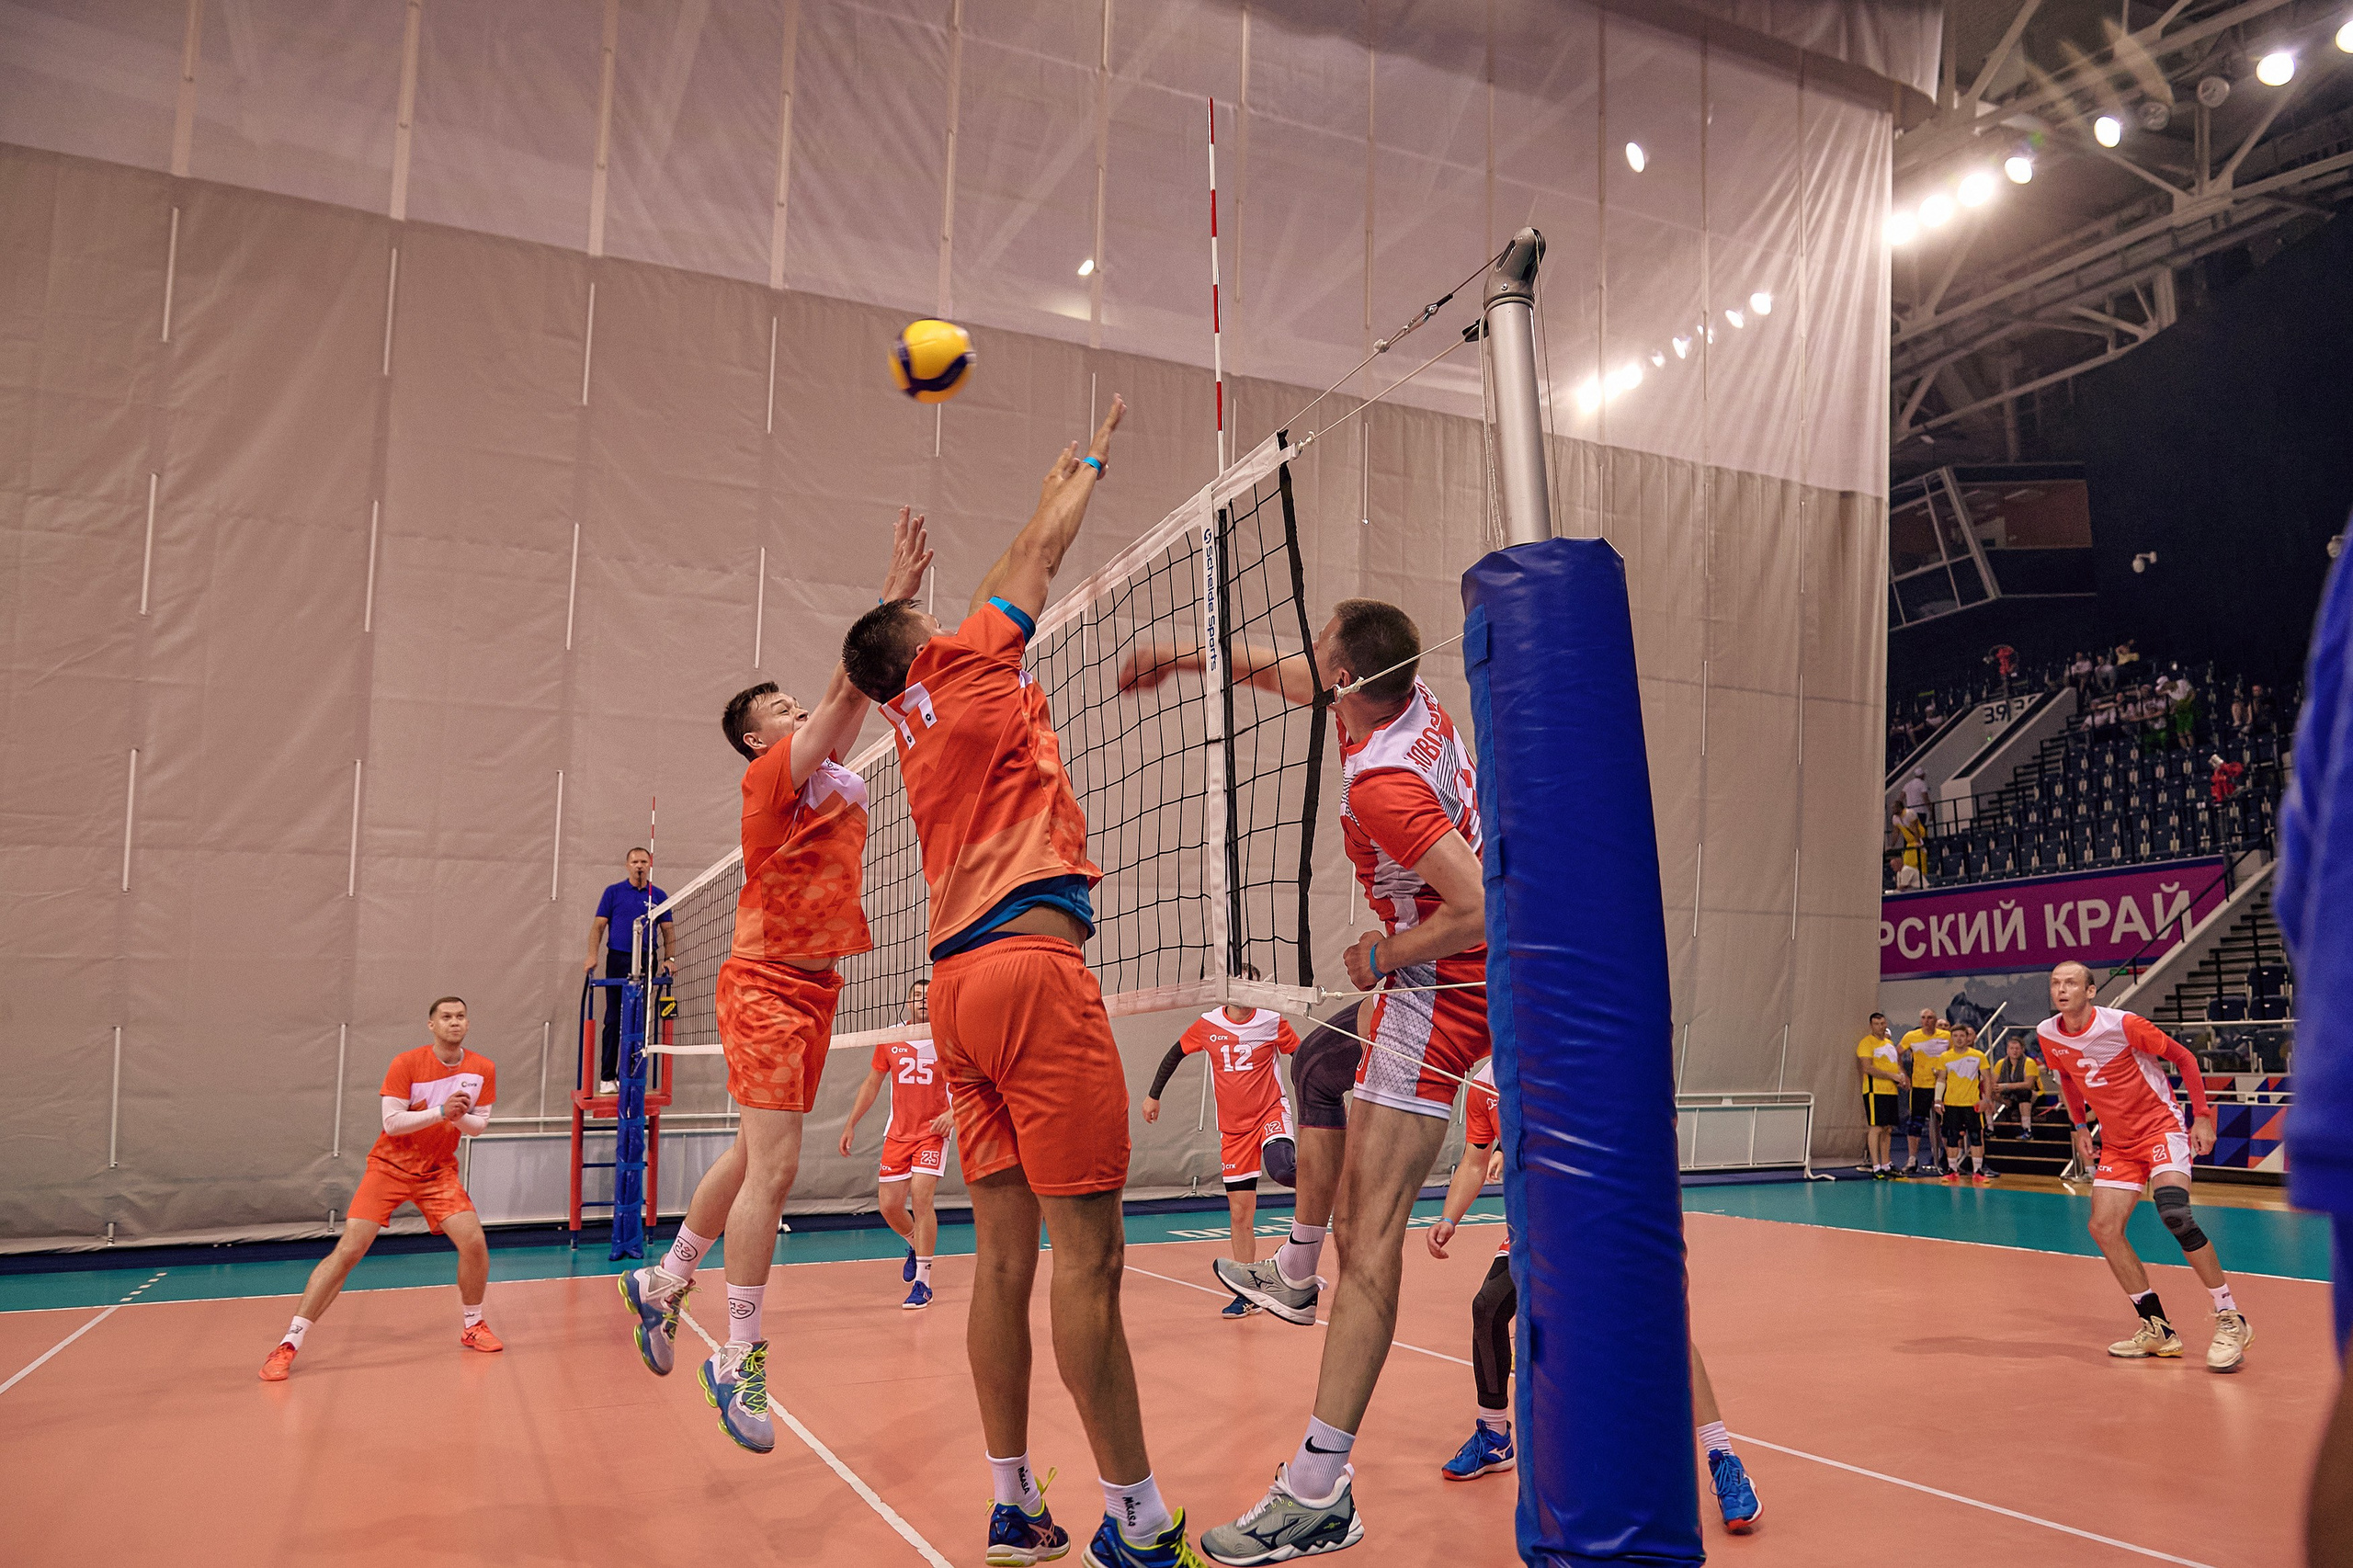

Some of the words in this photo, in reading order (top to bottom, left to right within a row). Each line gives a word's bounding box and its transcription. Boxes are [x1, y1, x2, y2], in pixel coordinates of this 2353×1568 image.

[1207, 615, 1218, 671] Sports
[2043, 881, 2192, 949] КРАЙ
[898, 1057, 935, 1085] 25
[1220, 1044, 1254, 1072] 12
[2076, 1057, 2108, 1088] 2
[1264, 1120, 1282, 1136] 12
[920, 1150, 939, 1166] 25
[2153, 1143, 2167, 1163] 2
